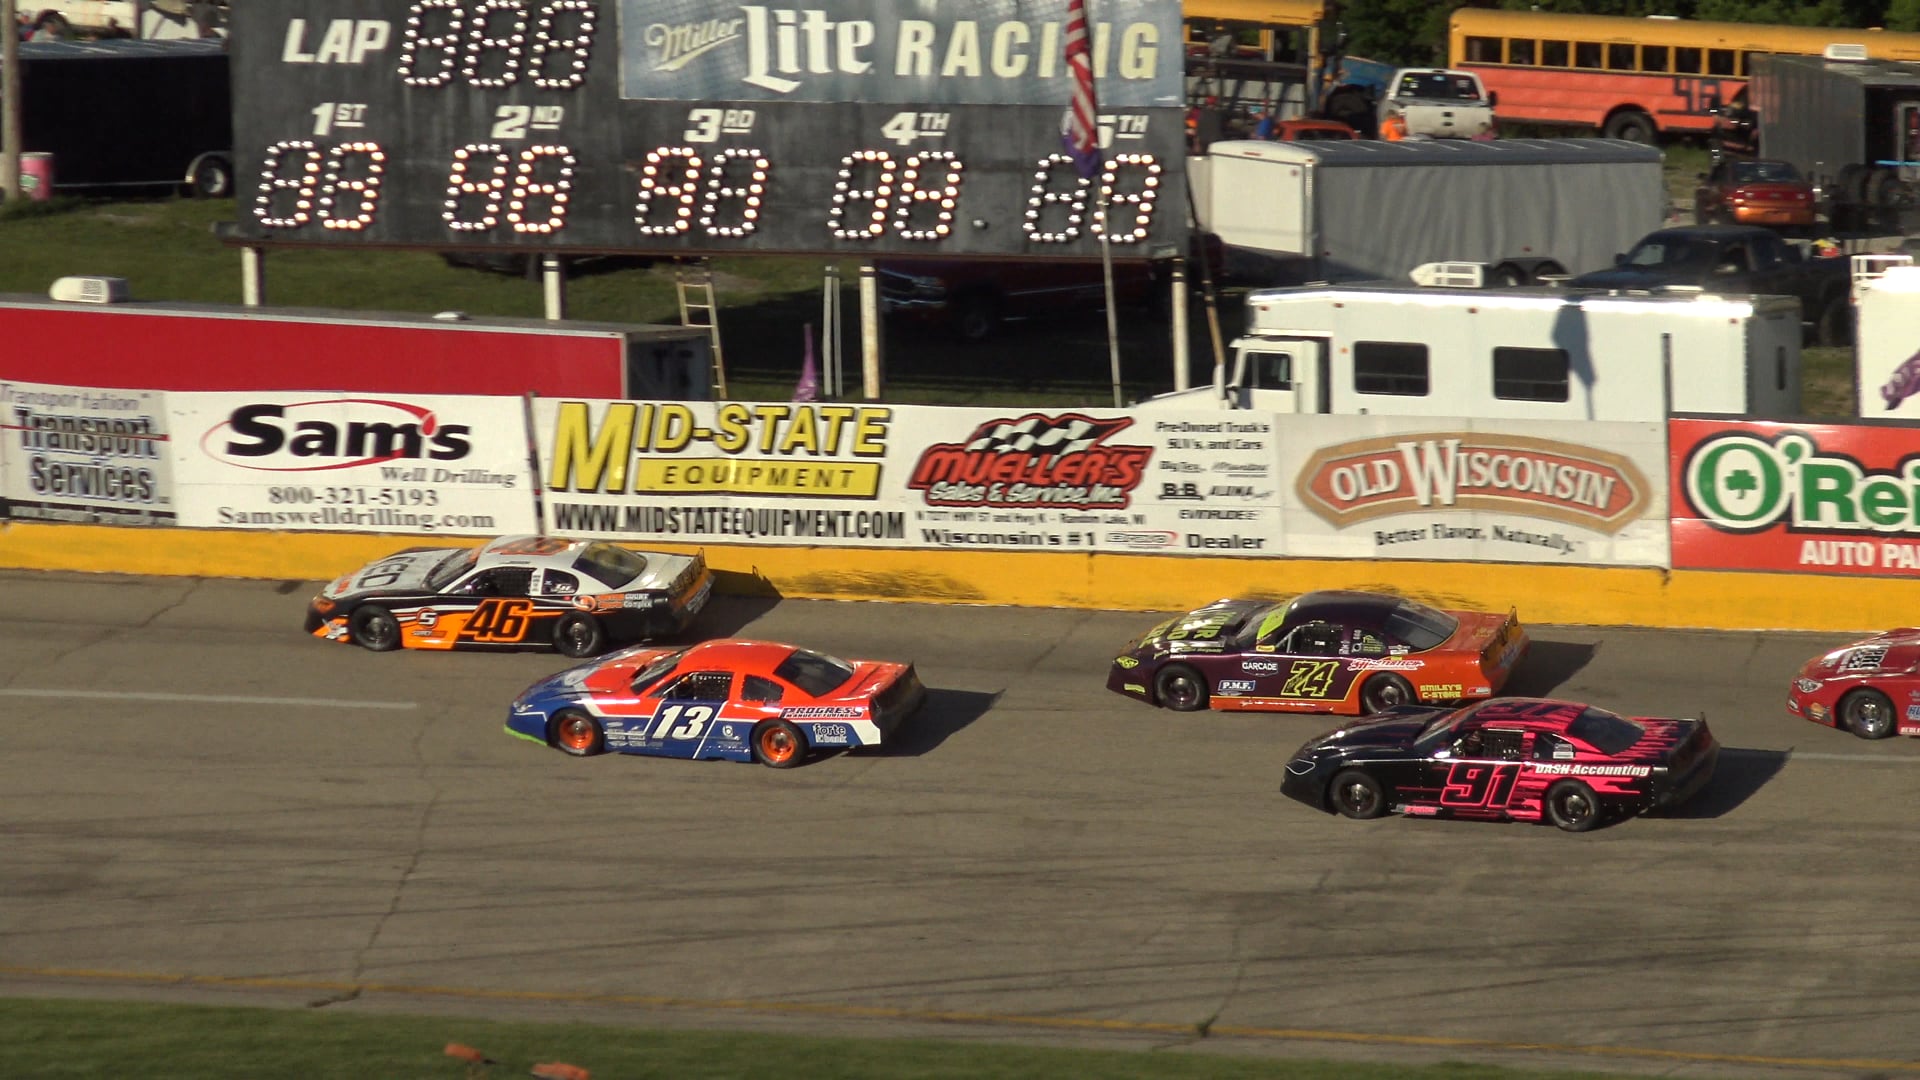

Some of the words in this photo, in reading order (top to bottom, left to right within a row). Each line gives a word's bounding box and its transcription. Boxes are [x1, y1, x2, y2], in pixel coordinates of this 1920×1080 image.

[282, 19, 391, 64] LAP
[645, 19, 744, 72] Miller
[738, 5, 875, 93] Lite
[14, 406, 158, 459] Transport
[549, 400, 892, 494] MID-STATE
[31, 453, 154, 503] Services
[381, 466, 427, 483] Well
[432, 467, 516, 488] Drilling
[662, 465, 856, 489] EQUIPMENT
[914, 449, 1144, 486] MUELLER'S
[1330, 459, 1401, 502] OLD
[268, 487, 439, 506] 800-321-5193
[928, 480, 987, 501] Sales
[987, 483, 1003, 501] &
[217, 506, 496, 531] Samswelldrilling.com
[553, 502, 905, 539] WWW.MIDSTATEEQUIPMENT.COM
[920, 529, 1061, 546] Wisconsin's
[1186, 534, 1267, 549] Dealer
[1374, 529, 1427, 545] Better
[1432, 523, 1487, 541] Flavor,
[1800, 540, 1876, 567] AUTO
[459, 598, 534, 642] 46
[1222, 681, 1252, 690] P.M.F.
[1281, 661, 1340, 697] 74
[1420, 684, 1462, 692] SMILEY'S
[652, 704, 714, 740] 13
[779, 706, 863, 718] PROGRESS
[813, 723, 846, 737] forte
[1440, 762, 1522, 808] 91
